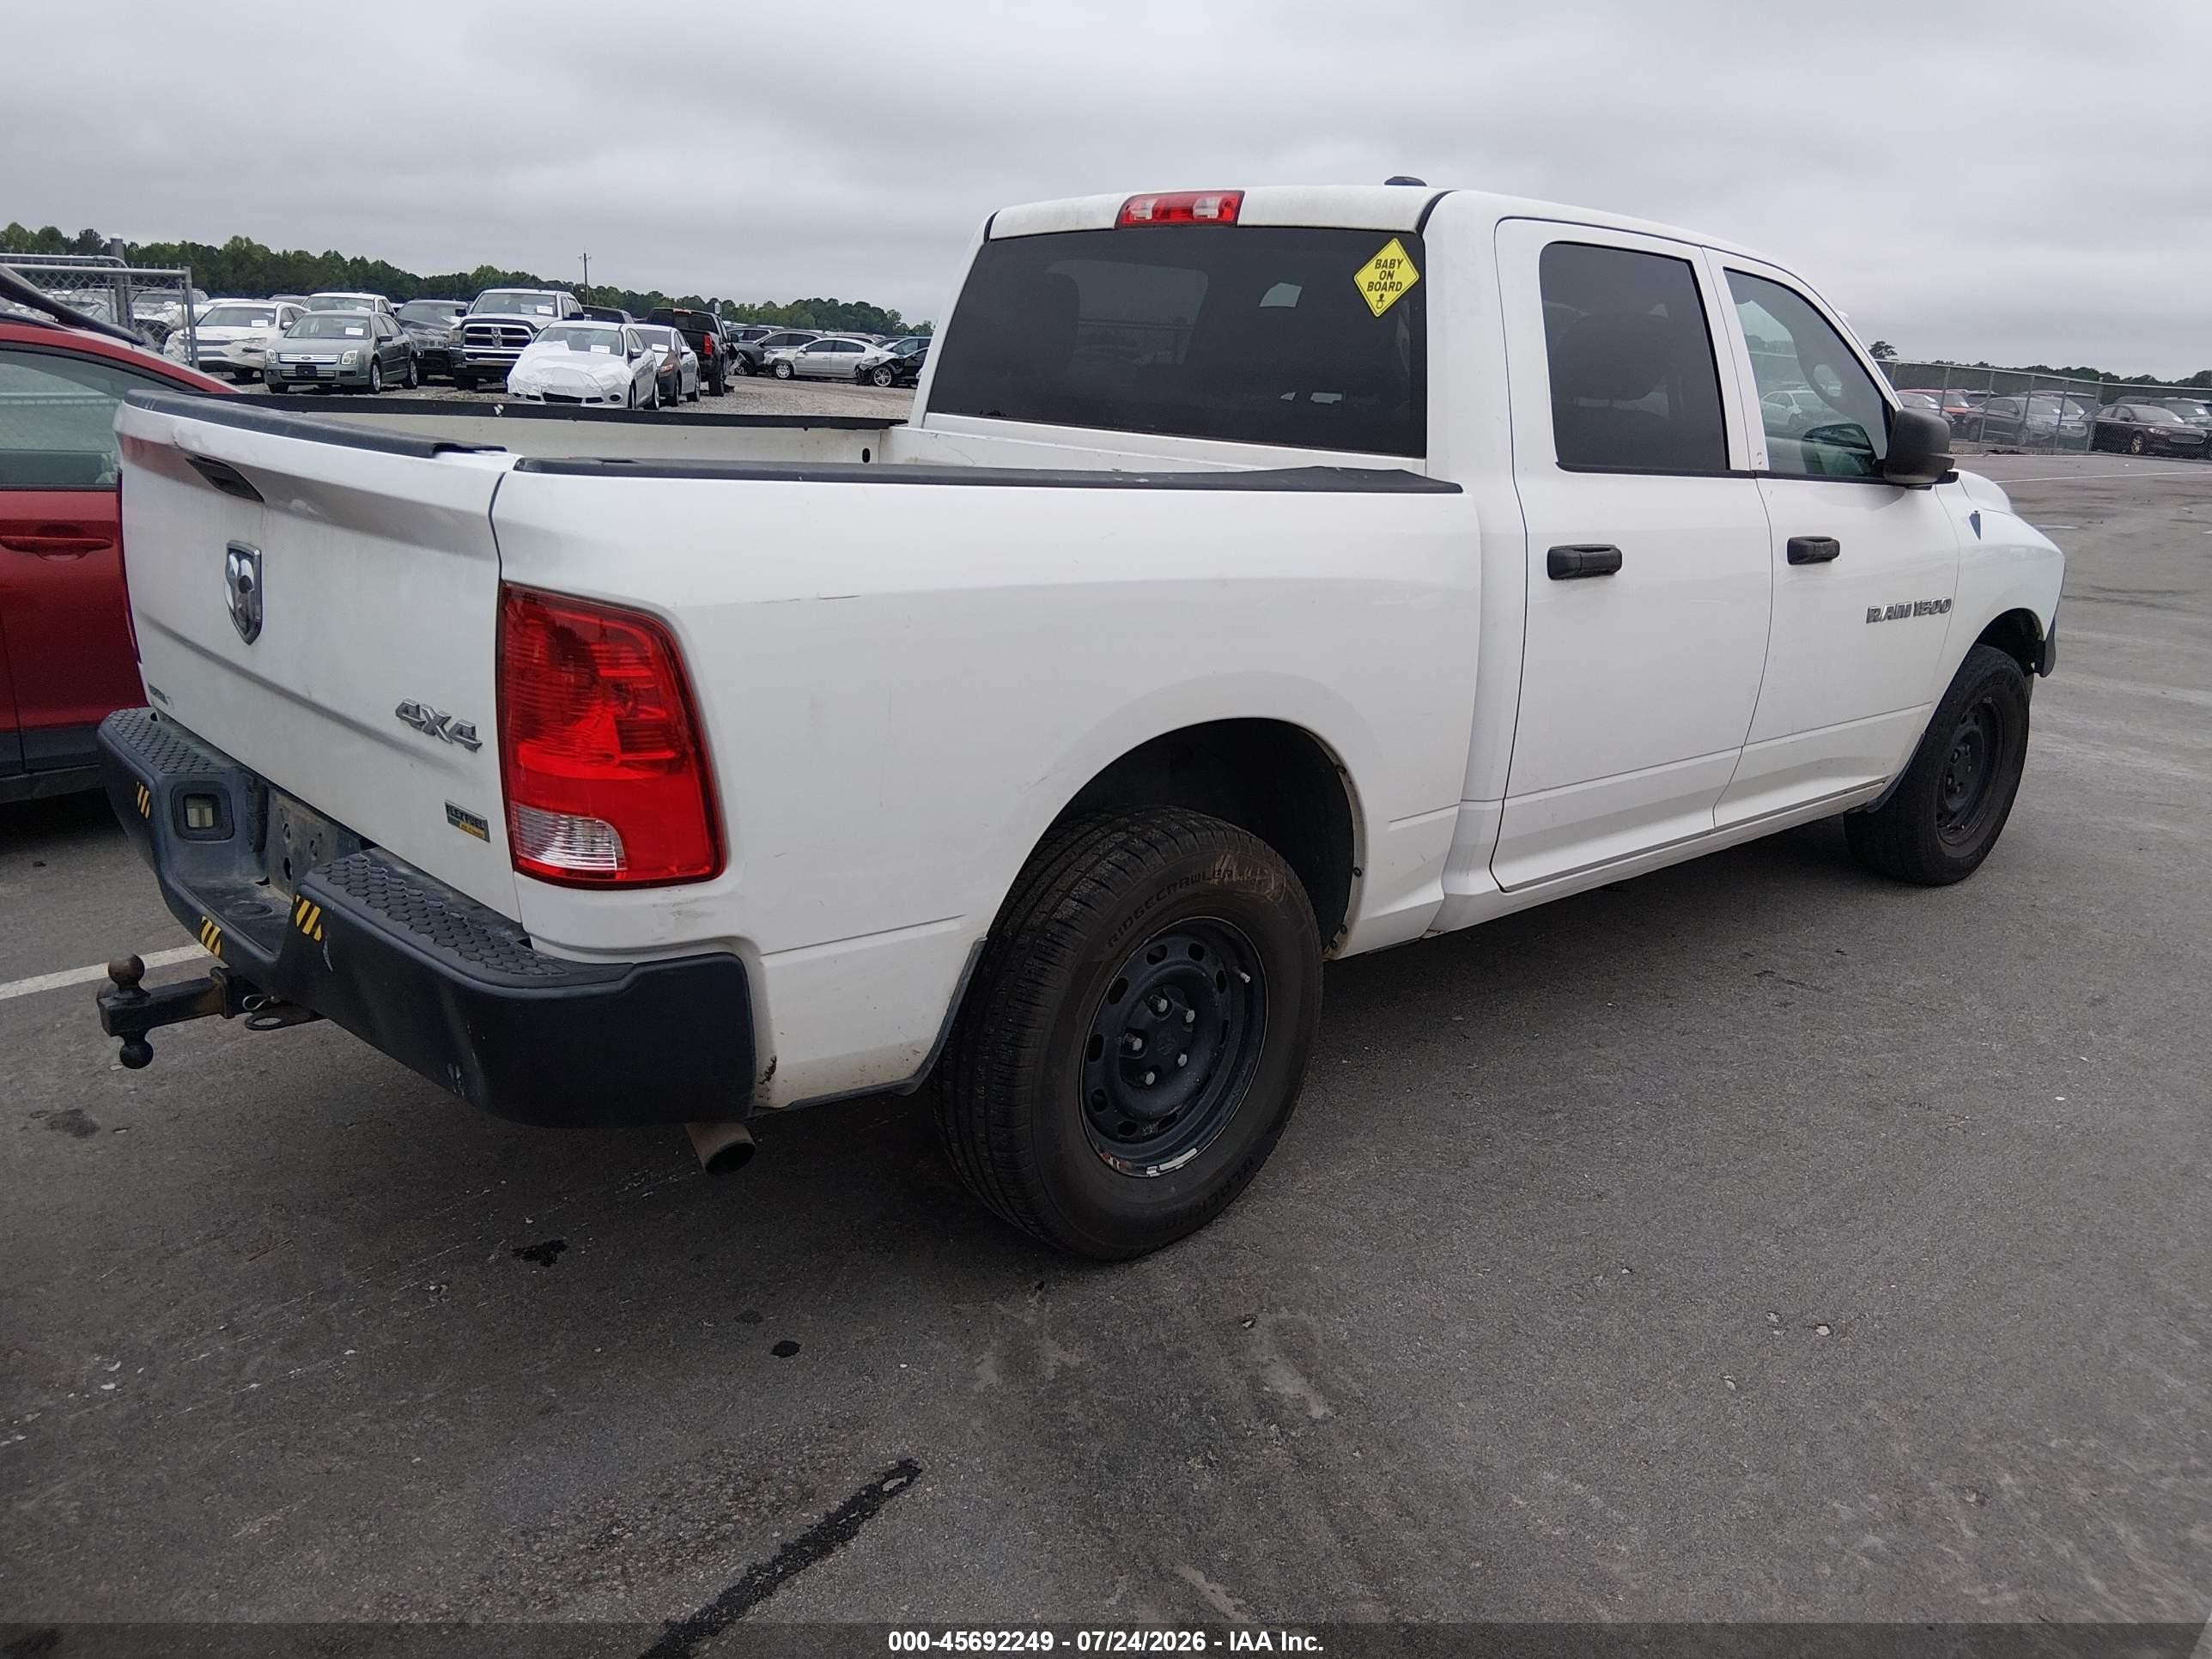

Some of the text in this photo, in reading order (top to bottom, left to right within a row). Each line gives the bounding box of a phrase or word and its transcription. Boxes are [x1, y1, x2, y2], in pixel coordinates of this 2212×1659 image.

[1375, 258, 1403, 269] BABY
[1379, 270, 1395, 280] ON
[1367, 282, 1402, 292] BOARD
[1865, 598, 1952, 623] RAM 1500
